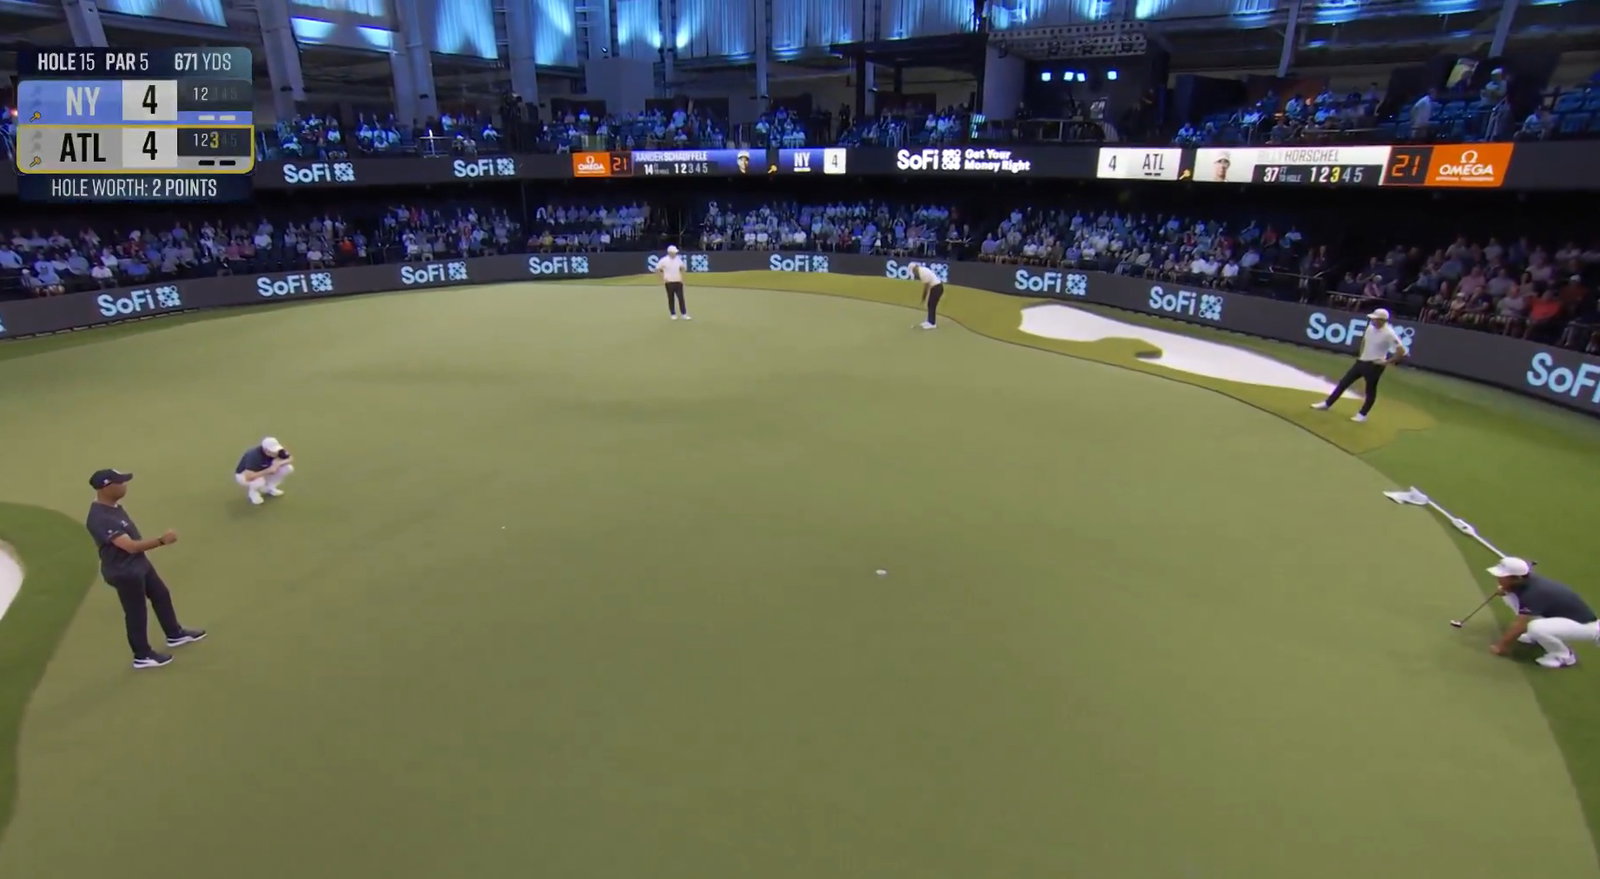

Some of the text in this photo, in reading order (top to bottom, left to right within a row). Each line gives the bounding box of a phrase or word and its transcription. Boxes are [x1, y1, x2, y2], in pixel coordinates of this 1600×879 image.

[793, 151, 811, 167] NY
[831, 154, 839, 168] 4
[897, 149, 939, 170] SoFi
[964, 148, 1012, 160] Get Your
[1108, 155, 1117, 171] 4
[1142, 153, 1165, 171] ATL
[283, 163, 331, 184] SoFi
[453, 159, 494, 178] SoFi
[612, 157, 627, 171] 21
[644, 163, 654, 175] 14
[964, 160, 1031, 174] Money Right
[1391, 155, 1421, 177] 21
[1439, 164, 1494, 175] OMEGA
[1263, 166, 1280, 183] 37
[529, 256, 569, 275] SoFi
[770, 254, 810, 273] SoFi
[401, 263, 446, 286] SoFi
[1014, 270, 1061, 294] SoFi
[257, 274, 307, 298] SoFi
[97, 289, 156, 317] SoFi
[1149, 286, 1197, 317] SoFi
[1306, 312, 1368, 346] SoF
